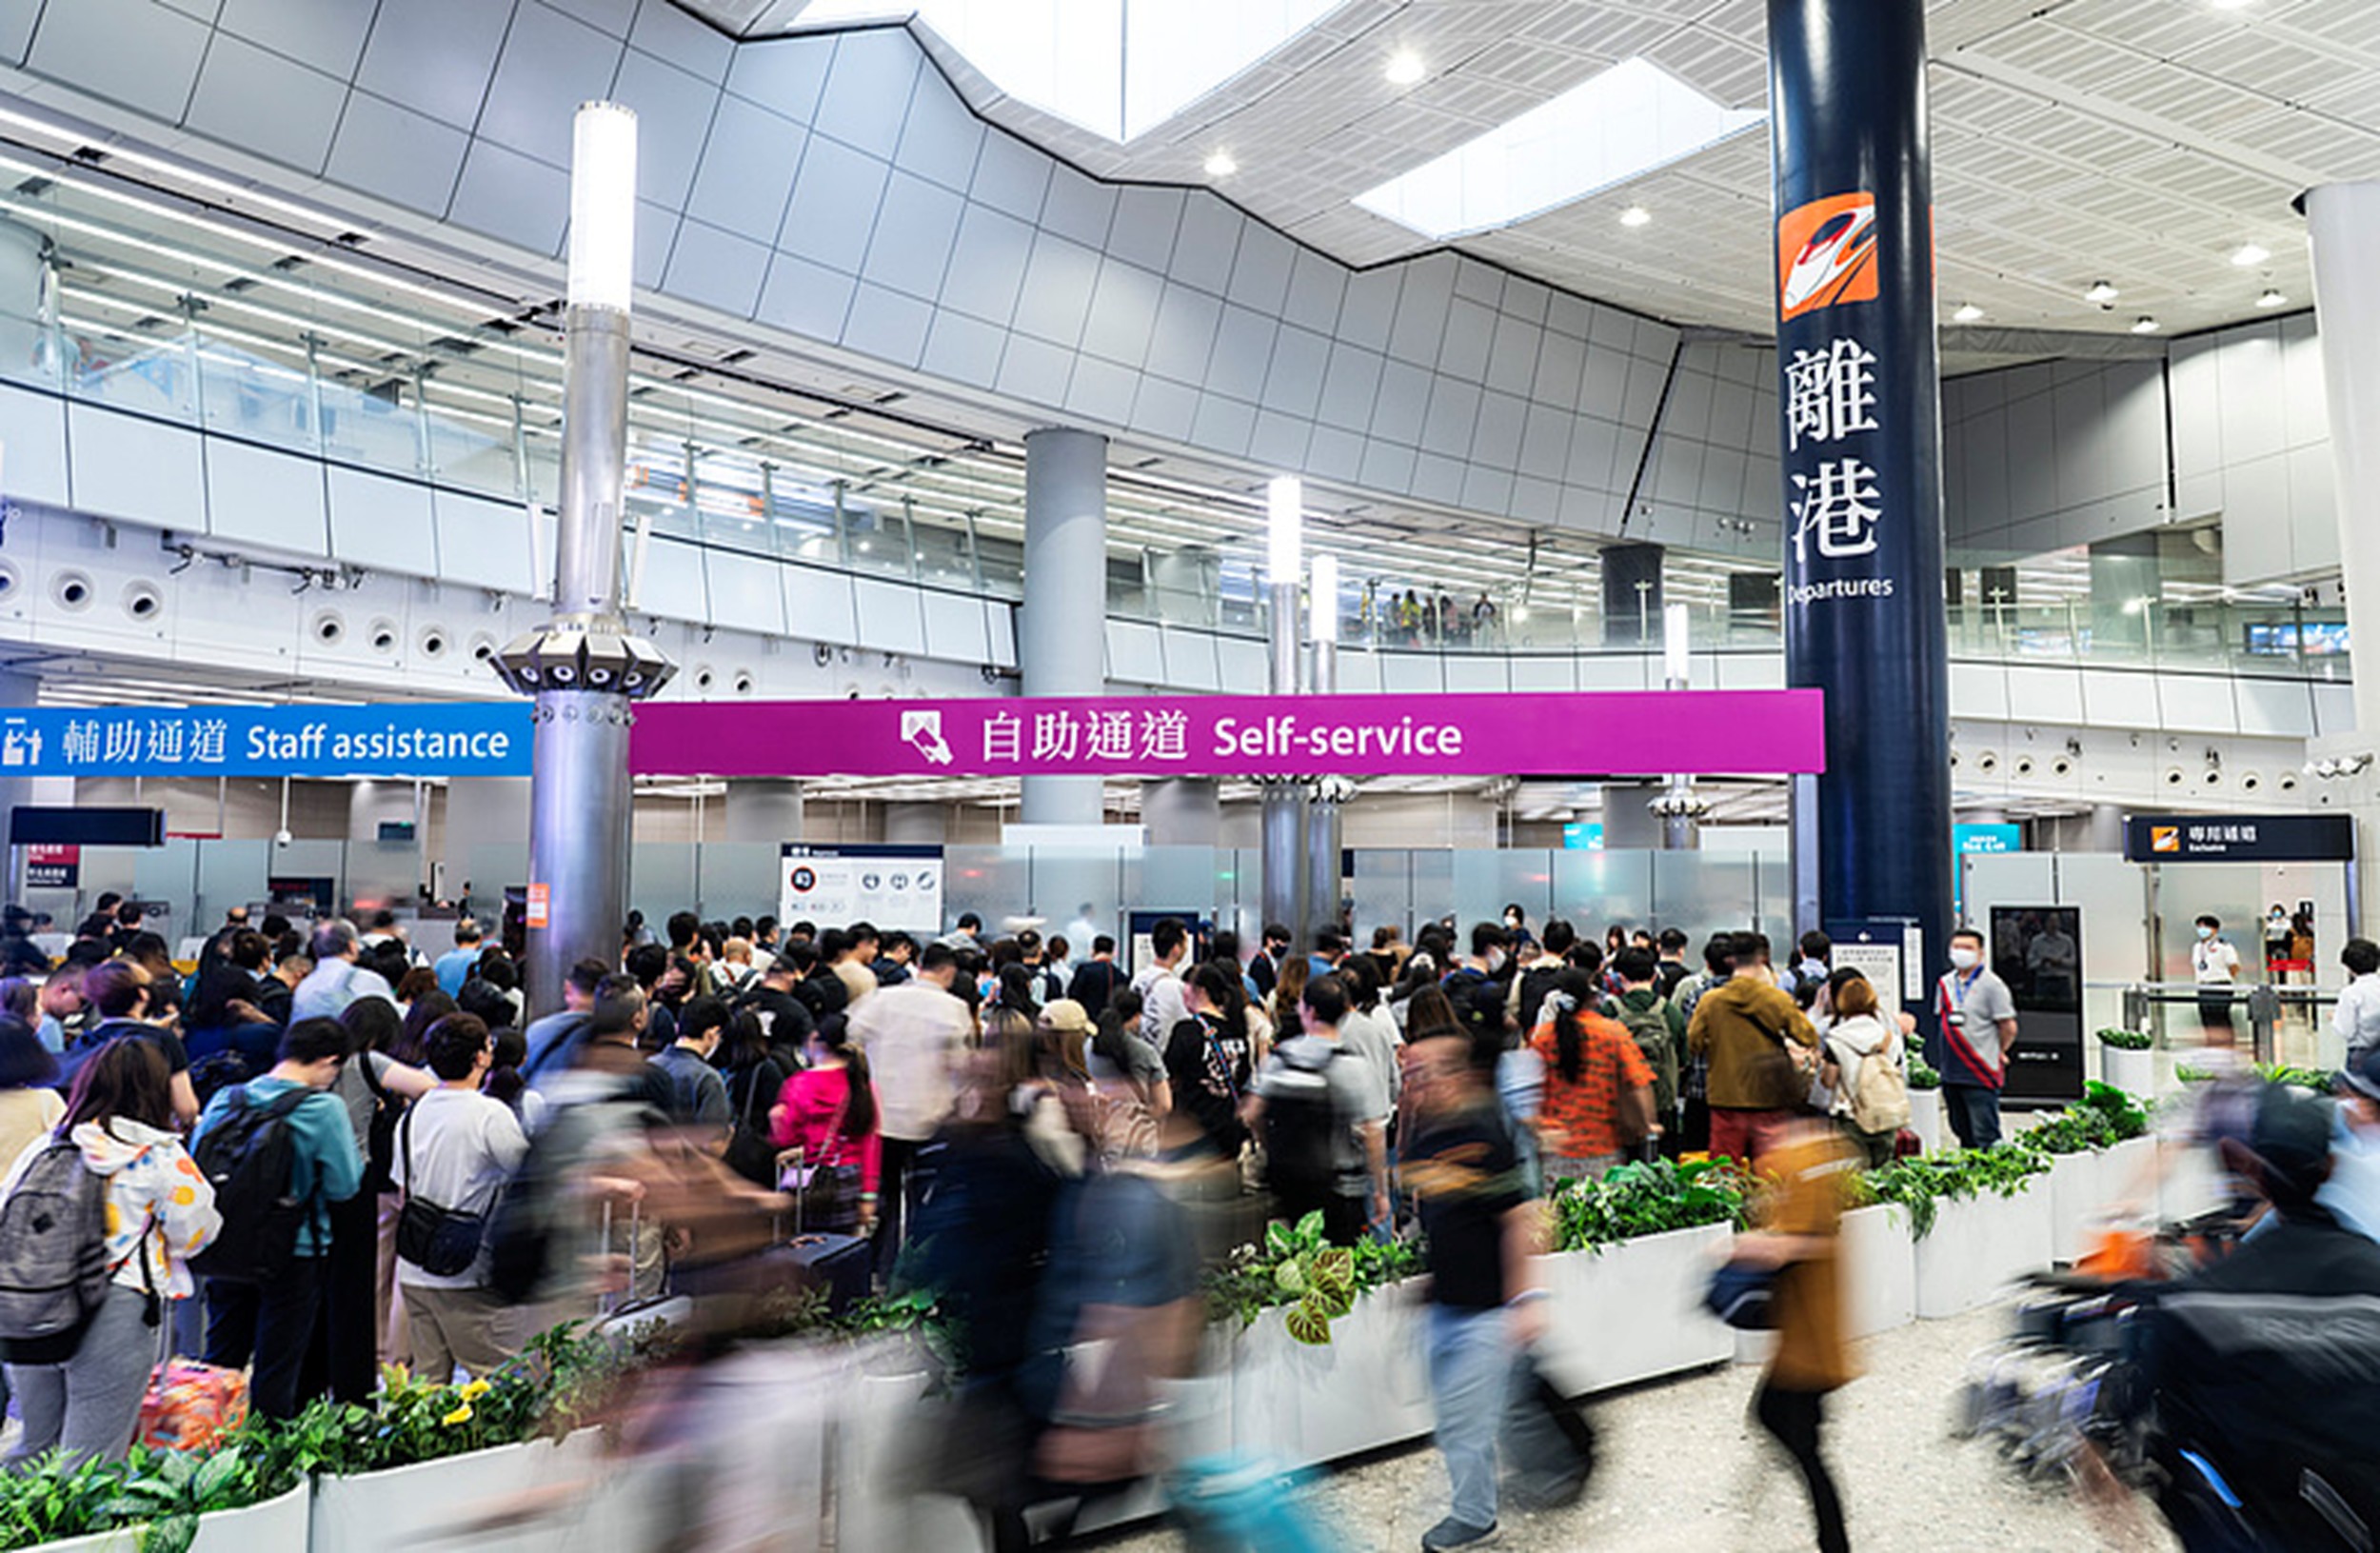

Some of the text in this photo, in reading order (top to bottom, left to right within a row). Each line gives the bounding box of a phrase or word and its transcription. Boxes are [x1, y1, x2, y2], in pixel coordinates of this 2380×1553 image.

[1785, 339, 1882, 563] 離港
[62, 719, 228, 764] 輔助通道
[247, 724, 510, 760] Staff assistance
[982, 709, 1188, 762] 自助通道
[1213, 716, 1463, 757] Self-service
